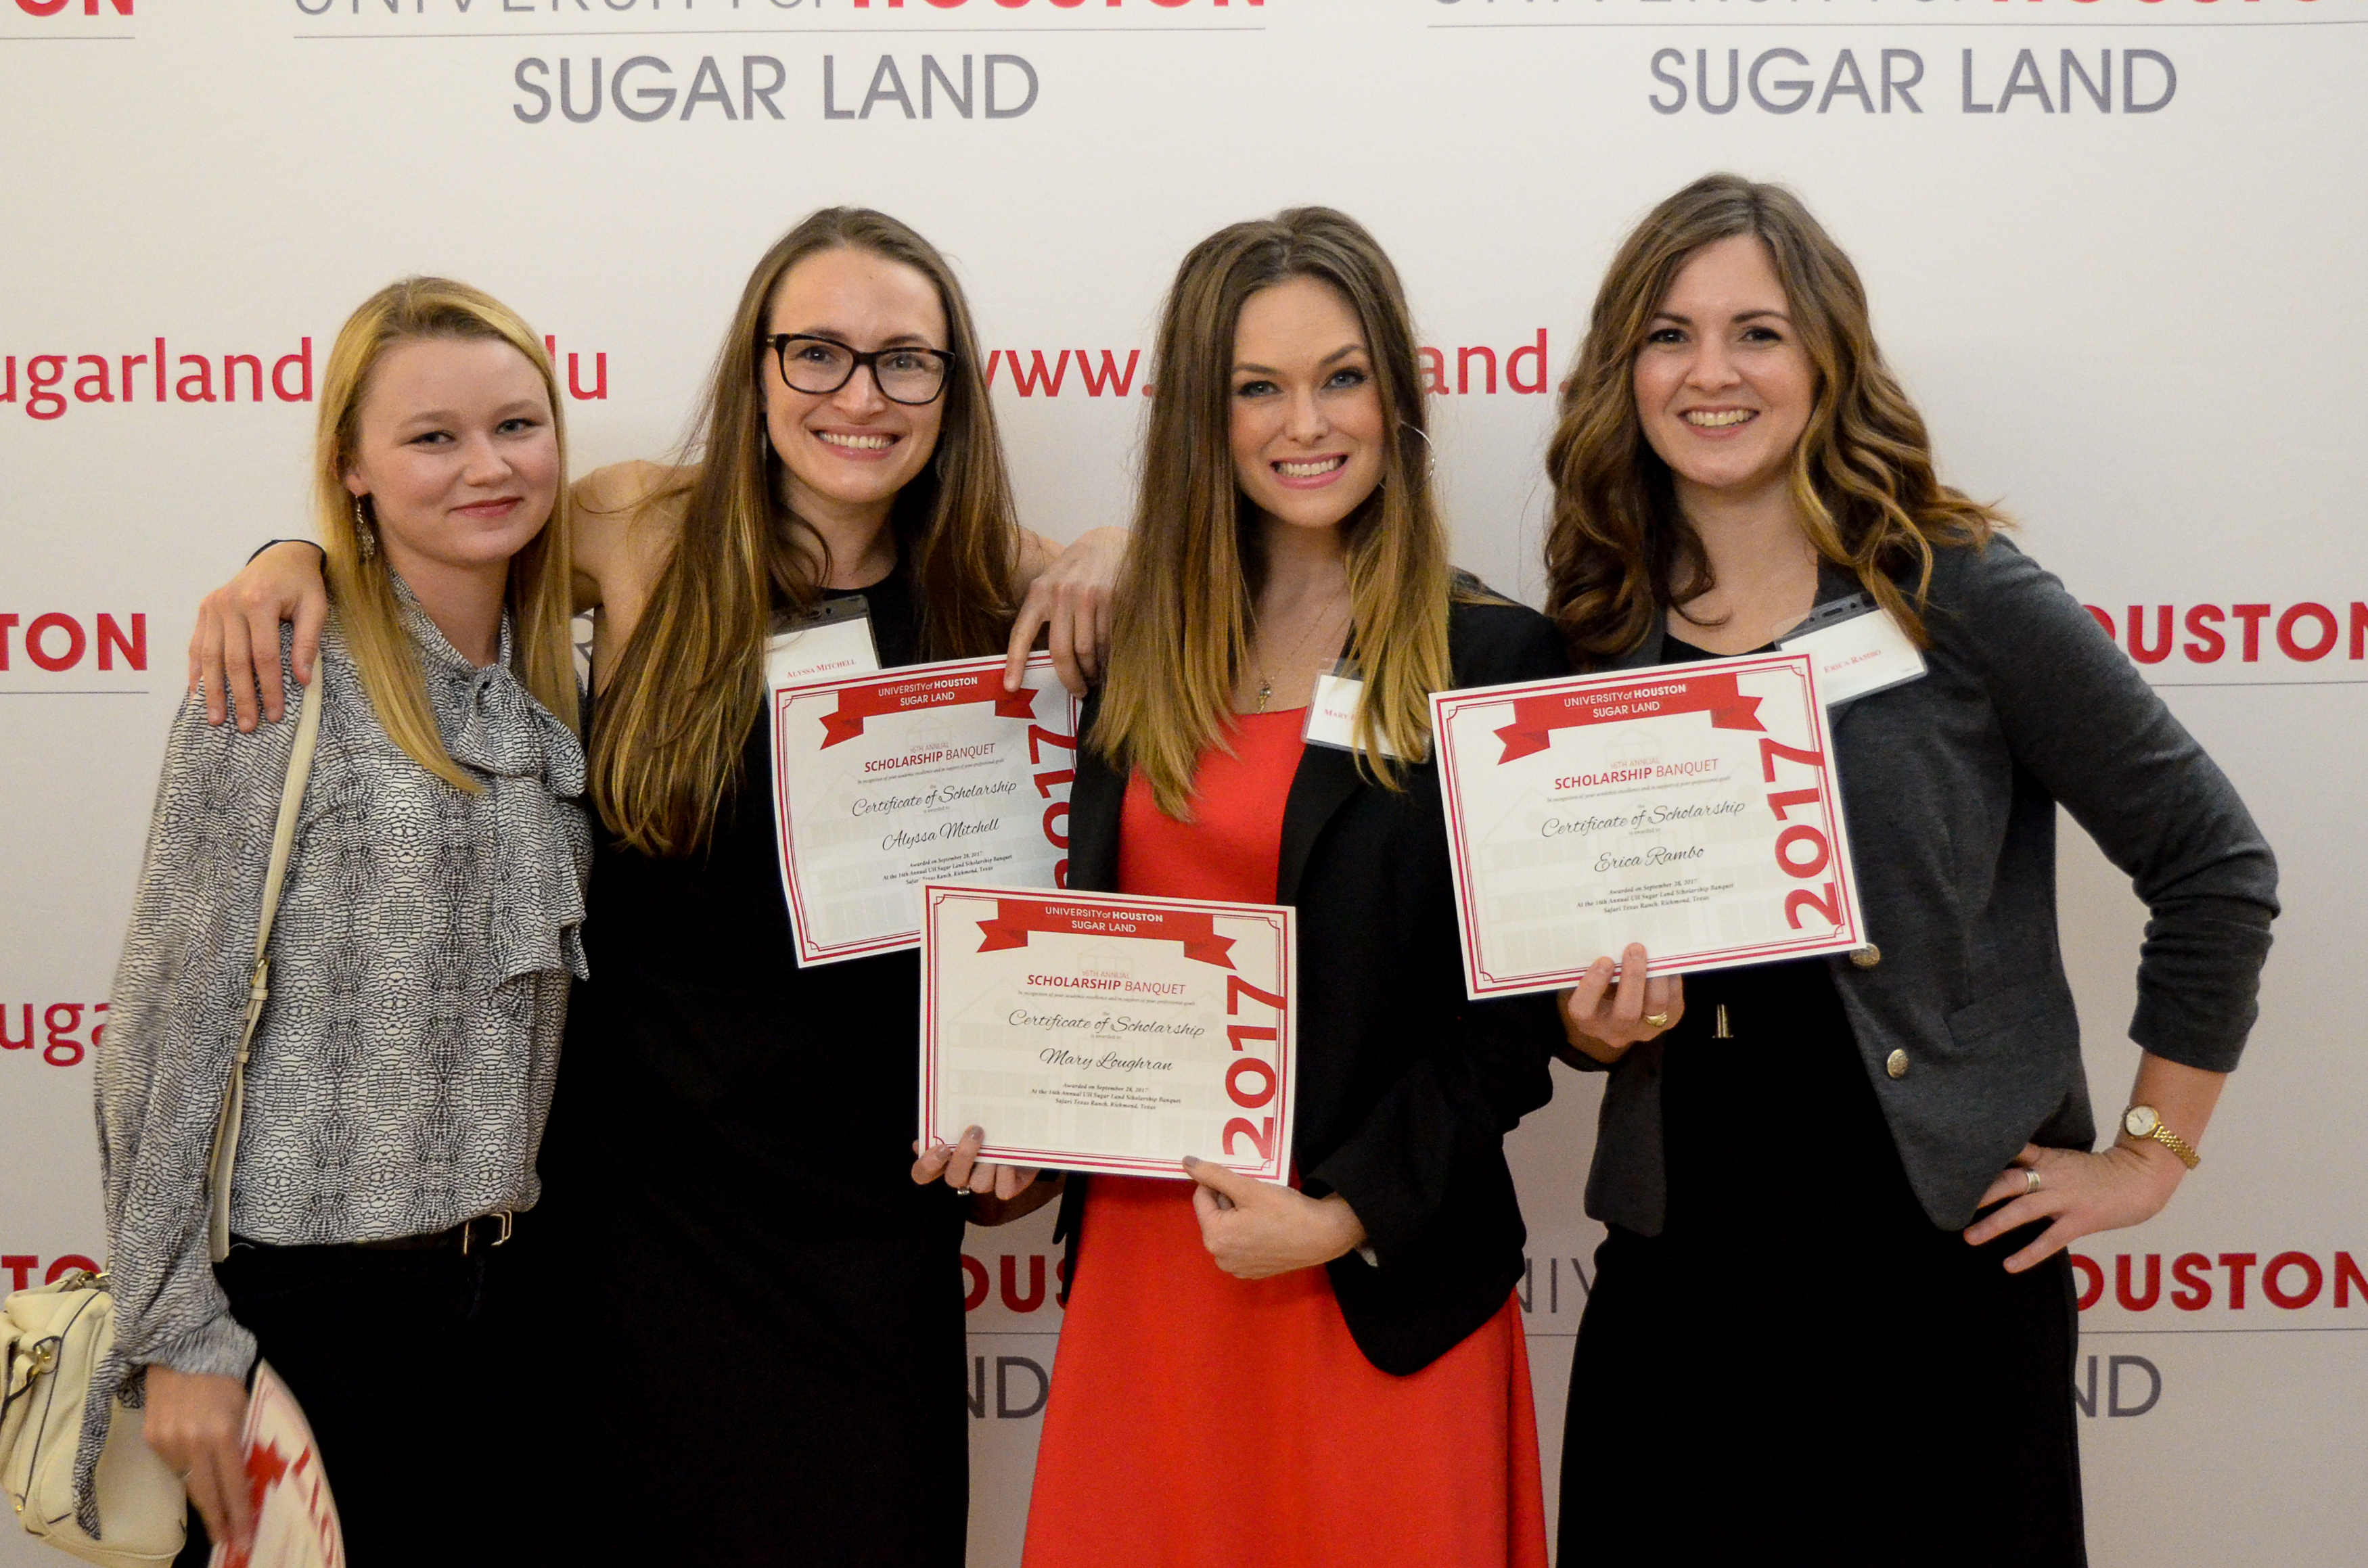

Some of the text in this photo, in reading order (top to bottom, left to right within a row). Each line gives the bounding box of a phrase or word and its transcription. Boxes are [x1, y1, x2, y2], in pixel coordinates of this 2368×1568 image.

[513, 54, 1039, 124] SUGAR LAND
[1647, 47, 2177, 115] SUGAR LAND
[934, 676, 978, 689] HOUSTON
[1633, 683, 1687, 699] HOUSTON
[900, 691, 955, 706] SUGAR LAND
[1593, 701, 1660, 718] SUGAR LAND
[864, 751, 943, 773] SCHOLARSHIP
[946, 742, 996, 760] BANQUET
[925, 742, 949, 751] ANNUAL
[1555, 758, 1718, 790] SCHOLARSHIP BANQUET
[852, 781, 1017, 816] Certificate of Scholarship
[1028, 724, 1078, 890] 017
[1541, 800, 1746, 838] Certificate of Scholarship
[882, 818, 999, 851] Alyssa Mitchell
[1759, 738, 1842, 930] 2017
[910, 859, 930, 867] Awarded
[938, 855, 962, 863] September
[965, 858, 993, 867] Scholarship
[1594, 846, 1704, 873] Erica Rambo
[1608, 896, 1630, 904] Annual
[1675, 886, 1709, 896] Scholarship
[1710, 883, 1734, 891] Banquet
[1610, 886, 1634, 894] Awarded
[1643, 883, 1672, 892] September
[1072, 919, 1137, 933] SUGAR LAND
[1112, 911, 1163, 923] HOUSTON
[1027, 974, 1186, 996] SCHOLARSHIP BANQUET
[1100, 971, 1130, 979] ANNUAL
[1008, 1009, 1205, 1039] Certificate of Scholarship
[1039, 1048, 1172, 1073] Mary Loughran
[1222, 975, 1287, 1159] 2017
[1093, 1092, 1110, 1100] Sugar
[1126, 1094, 1158, 1103] Scholarship
